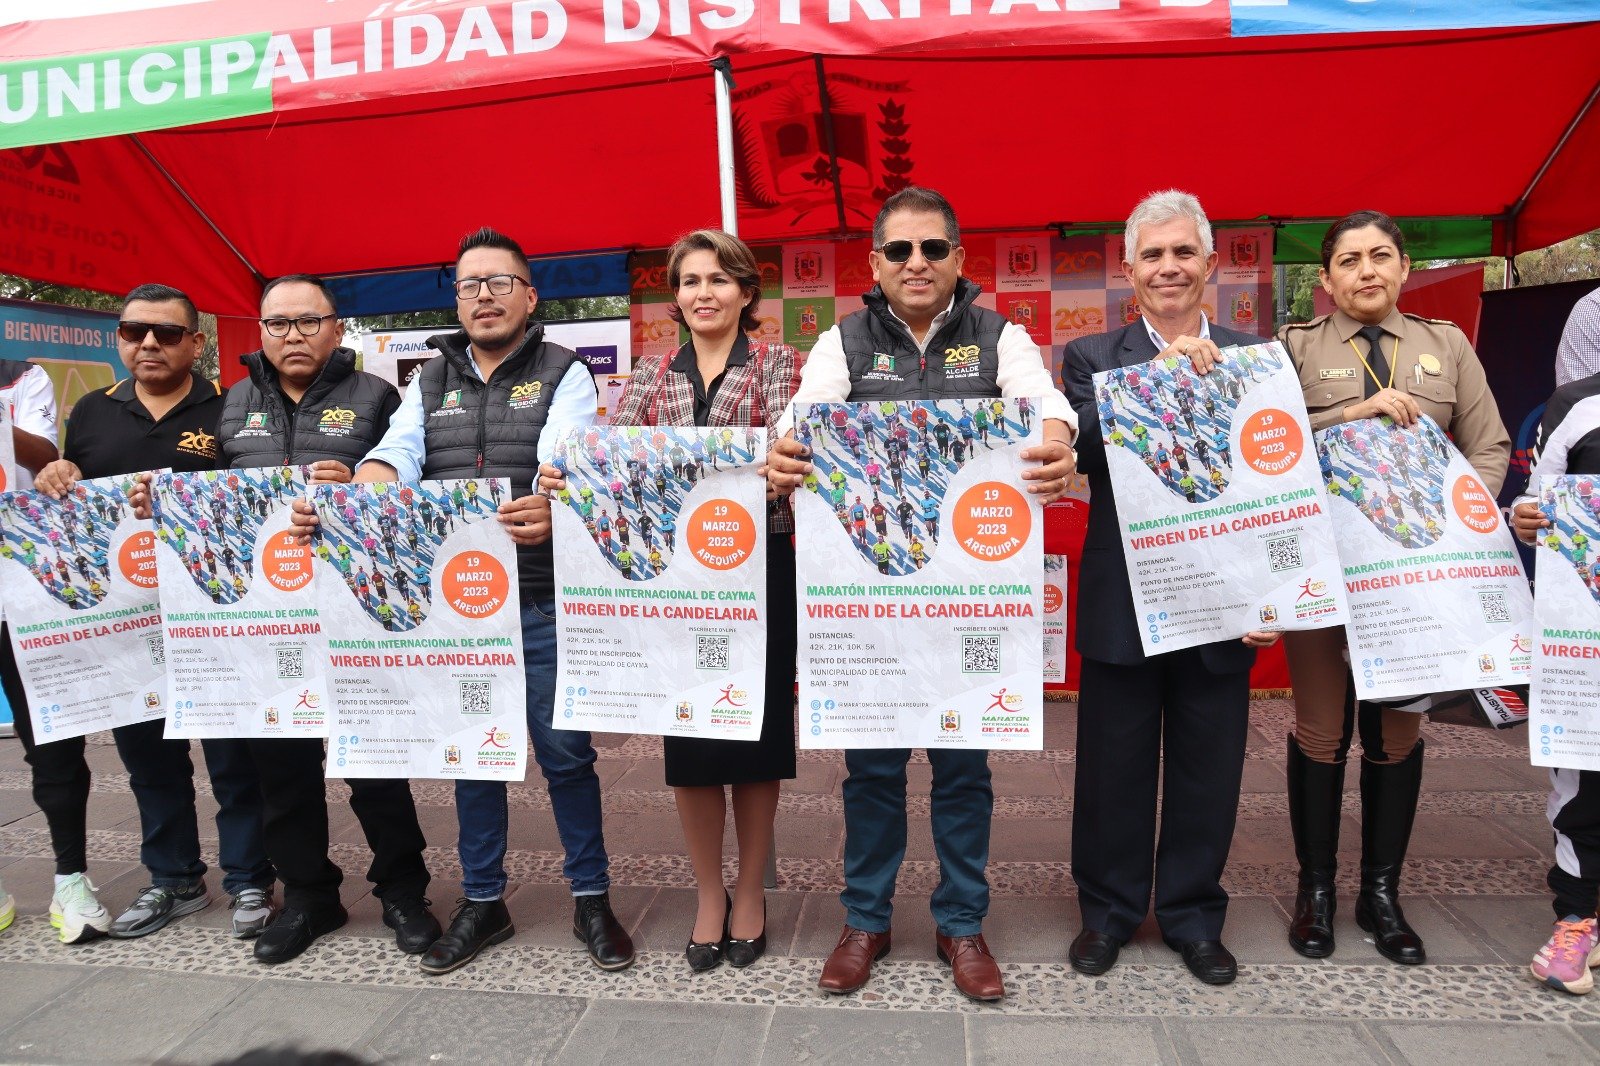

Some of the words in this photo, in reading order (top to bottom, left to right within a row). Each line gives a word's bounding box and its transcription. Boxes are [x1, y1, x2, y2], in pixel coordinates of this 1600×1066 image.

[0, 0, 568, 124] UNICIPALIDAD
[5, 320, 102, 348] BIENVENIDOS
[390, 343, 429, 352] TRAINE
[946, 366, 979, 374] ALCALDE
[1261, 416, 1273, 425] 19
[320, 427, 349, 435] REGIDOR
[1253, 427, 1286, 442] MARZO
[1261, 442, 1285, 455] 2023
[1252, 450, 1297, 471] AREQUIPA
[1467, 480, 1474, 489] 19
[984, 490, 999, 501] 19
[1462, 492, 1486, 501] MARZO
[714, 506, 727, 516] 19
[970, 507, 1013, 518] MARZO
[1129, 515, 1177, 532] MARATÓN
[1182, 501, 1263, 523] INTERNACIONAL
[1265, 496, 1277, 506] DE
[1280, 487, 1316, 503] CAYMA
[1470, 505, 1488, 514] 2023
[702, 522, 739, 531] MARZO
[1131, 530, 1185, 550] VIRGEN
[1189, 527, 1207, 541] DE
[1212, 524, 1229, 536] LA
[1232, 502, 1322, 531] CANDELARIA
[1464, 516, 1497, 530] AREQUIPA
[977, 524, 1007, 535] 2023
[139, 537, 150, 545] 19
[284, 537, 294, 545] 19
[708, 537, 734, 547] 2023
[963, 537, 1020, 557] AREQUIPA
[130, 549, 156, 559] MARZ
[274, 549, 304, 558] MARZO
[697, 548, 745, 566] AREQUIPA
[138, 561, 157, 570] 202
[279, 562, 300, 572] 2023
[467, 558, 480, 567] 19
[1137, 557, 1177, 567] DISTANCIAS:
[1344, 559, 1394, 576] MARATÓN
[1397, 552, 1473, 567] INTERNACIONAL
[1475, 552, 1485, 560] DE
[1488, 550, 1514, 559] CAYMA
[270, 572, 310, 587] AREQUIPA
[456, 572, 493, 582] MARZO
[1346, 575, 1400, 594] VIRGEN
[1405, 572, 1423, 585] DE
[1427, 569, 1445, 581] LA
[1448, 565, 1520, 579] CANDELARIA
[463, 587, 489, 597] 2023
[563, 586, 612, 598] MARATÓN
[615, 589, 698, 600] INTERNACIONAL
[701, 591, 715, 600] DE
[718, 591, 756, 601] CAYMA
[807, 583, 865, 596] MARATÓN
[869, 585, 966, 596] INTERNACIONAL
[970, 585, 985, 595] DE
[988, 584, 1032, 595] CAYMA
[453, 597, 500, 615] AREQUIPA
[806, 604, 869, 618] VIRGEN
[874, 604, 896, 618] DE
[901, 604, 921, 618] LA
[925, 603, 1034, 618] CANDELARIA
[1352, 600, 1392, 611] DISTANCIAS:
[167, 611, 205, 621] MARATÓN
[208, 610, 273, 620] INTERNACIONAL
[276, 609, 286, 618] DE
[289, 608, 318, 617] CAYMA
[563, 602, 616, 617] VIRGEN
[620, 604, 639, 618] DE
[643, 605, 660, 619] LA
[663, 605, 758, 621] CANDELARIA
[17, 620, 63, 635] MARATÓN
[65, 608, 141, 627] INTERNACIONAL
[143, 605, 156, 614] DE
[168, 627, 210, 638] VIRGEN
[213, 626, 228, 637] DE
[231, 626, 245, 637] LA
[248, 623, 321, 636] CANDELARIA
[1355, 623, 1377, 631] PUNTO
[20, 633, 70, 650] VIRGEN
[73, 630, 92, 641] DE
[94, 626, 111, 637] LA
[1544, 629, 1600, 640] MARATÓN
[328, 638, 374, 649] MARATÓN
[378, 638, 458, 649] INTERNACIONAL
[461, 638, 474, 647] DE
[477, 637, 512, 647] CAYMA
[330, 655, 381, 668] VIRGEN
[385, 654, 403, 667] DE
[407, 654, 424, 667] LA
[427, 653, 516, 666] CANDELARIA
[849, 656, 899, 664] INSCRIPCIÓN:
[1543, 668, 1587, 676] DISTANCIAS:
[1480, 689, 1511, 722] TRANSITO
[1541, 699, 1597, 707] MUNICIPALIDAD
